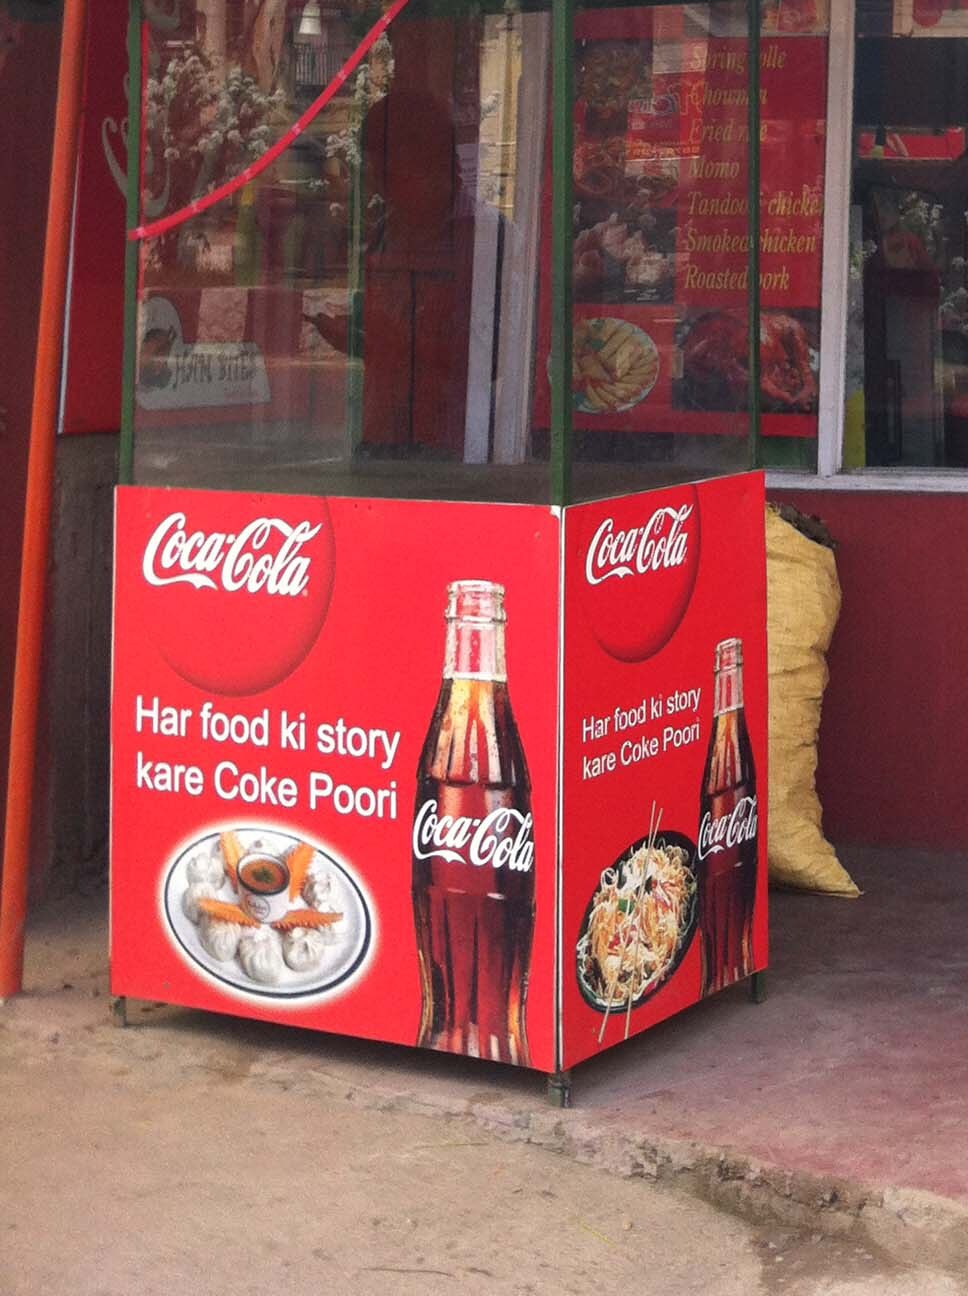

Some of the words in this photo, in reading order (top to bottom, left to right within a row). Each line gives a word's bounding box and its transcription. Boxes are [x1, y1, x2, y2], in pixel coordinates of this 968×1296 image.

[688, 117, 736, 144] Fried
[688, 160, 740, 179] Momo
[142, 511, 323, 597] Coca-Cola
[585, 504, 694, 585] Coca-Cola
[135, 695, 192, 738] Har
[199, 701, 268, 748] food
[280, 710, 306, 750] ki
[316, 719, 400, 770] story
[582, 715, 609, 744] Har
[612, 705, 648, 736] food
[650, 698, 663, 724] ki
[666, 686, 700, 722] story
[582, 752, 616, 780] kare
[620, 735, 659, 766] Coke
[663, 718, 701, 757] Poori
[135, 752, 204, 795] kare
[213, 760, 298, 807] Coke
[308, 772, 398, 820] Poori
[413, 798, 535, 873] Coca-Cola
